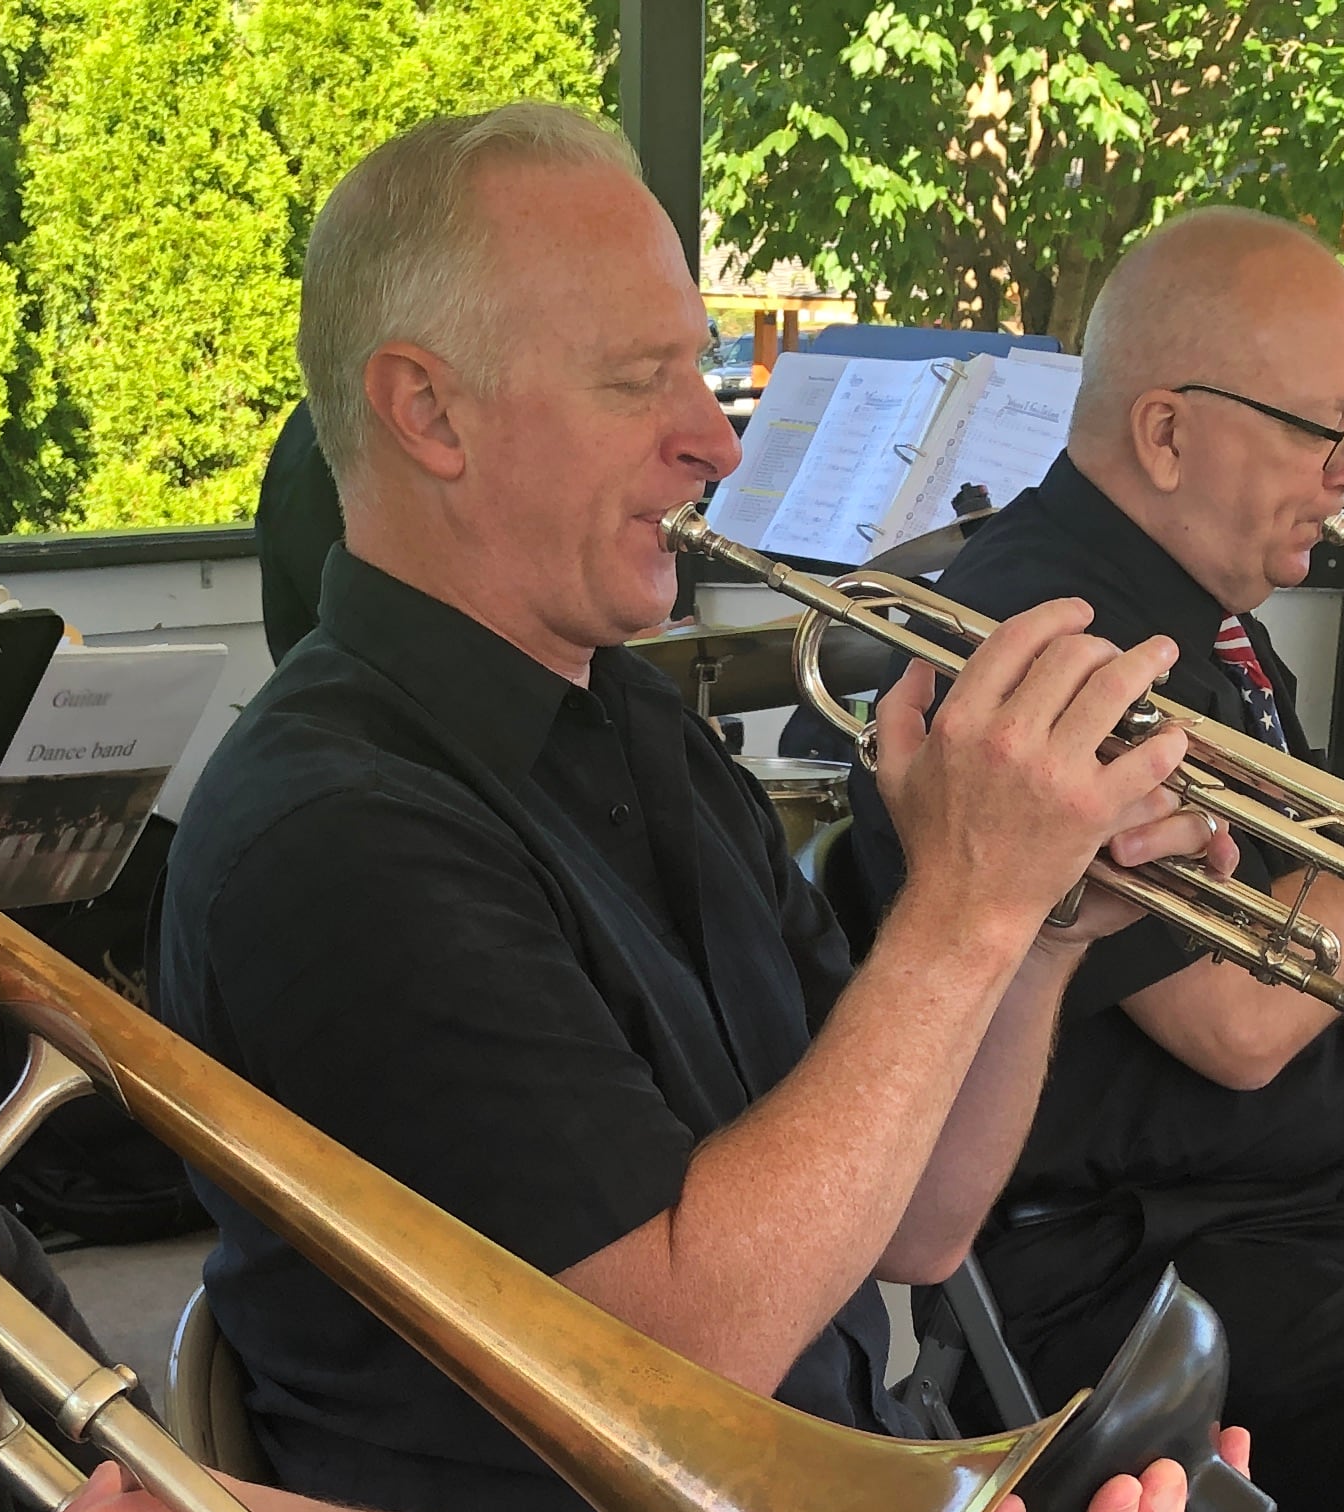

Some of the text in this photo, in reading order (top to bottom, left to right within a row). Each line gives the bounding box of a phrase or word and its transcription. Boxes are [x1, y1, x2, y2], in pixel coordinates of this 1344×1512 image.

[52, 689, 113, 708] Guitar
[27, 739, 137, 762] Dance band
